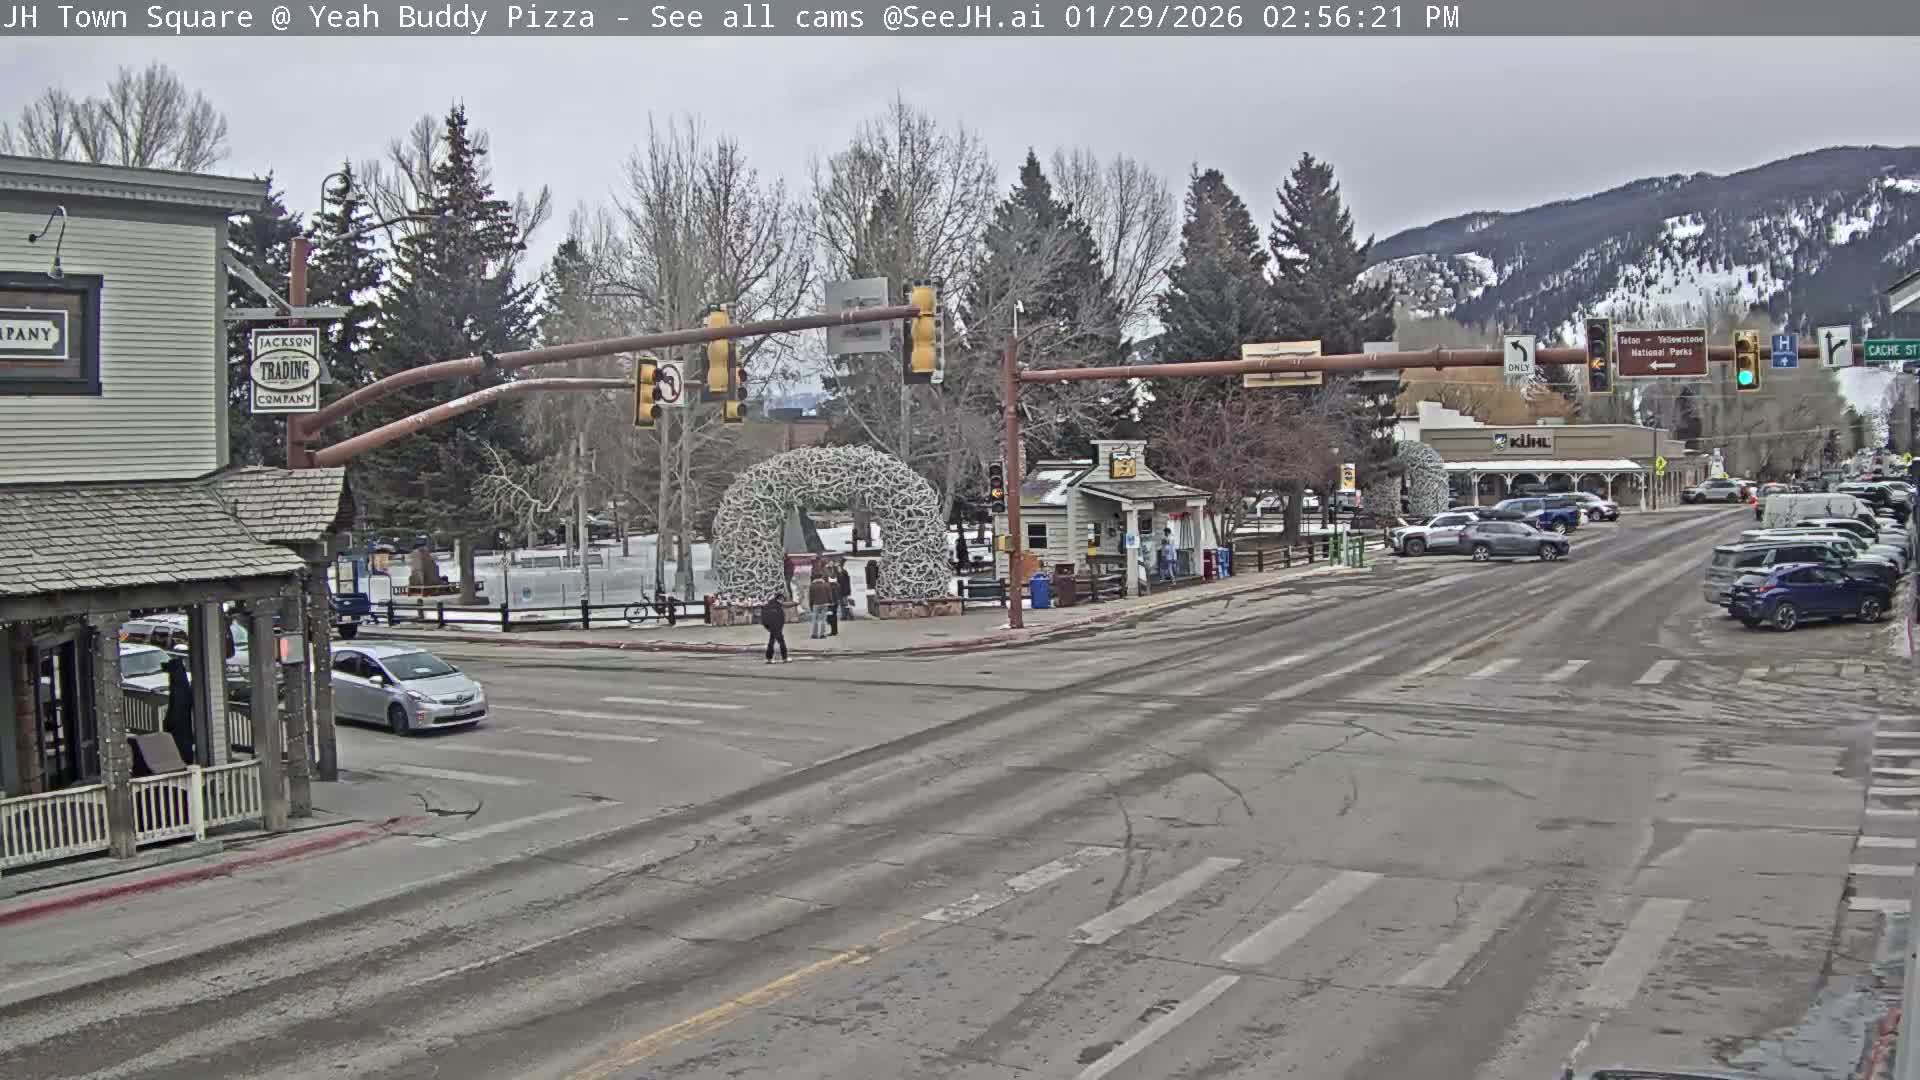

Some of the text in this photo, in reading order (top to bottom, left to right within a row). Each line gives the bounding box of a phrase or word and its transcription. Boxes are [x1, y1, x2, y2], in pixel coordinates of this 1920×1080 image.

[0, 327, 51, 341] PANY
[1620, 336, 1641, 345] Teton
[1657, 335, 1704, 344] Yellowstone
[260, 337, 312, 350] JACKSON
[1779, 335, 1790, 351] H
[1631, 347, 1693, 357] National Parks
[1868, 344, 1917, 356] CACHE ST
[260, 361, 310, 380] TRADING
[1508, 363, 1531, 371] ONLY
[257, 394, 312, 404] COMPANY
